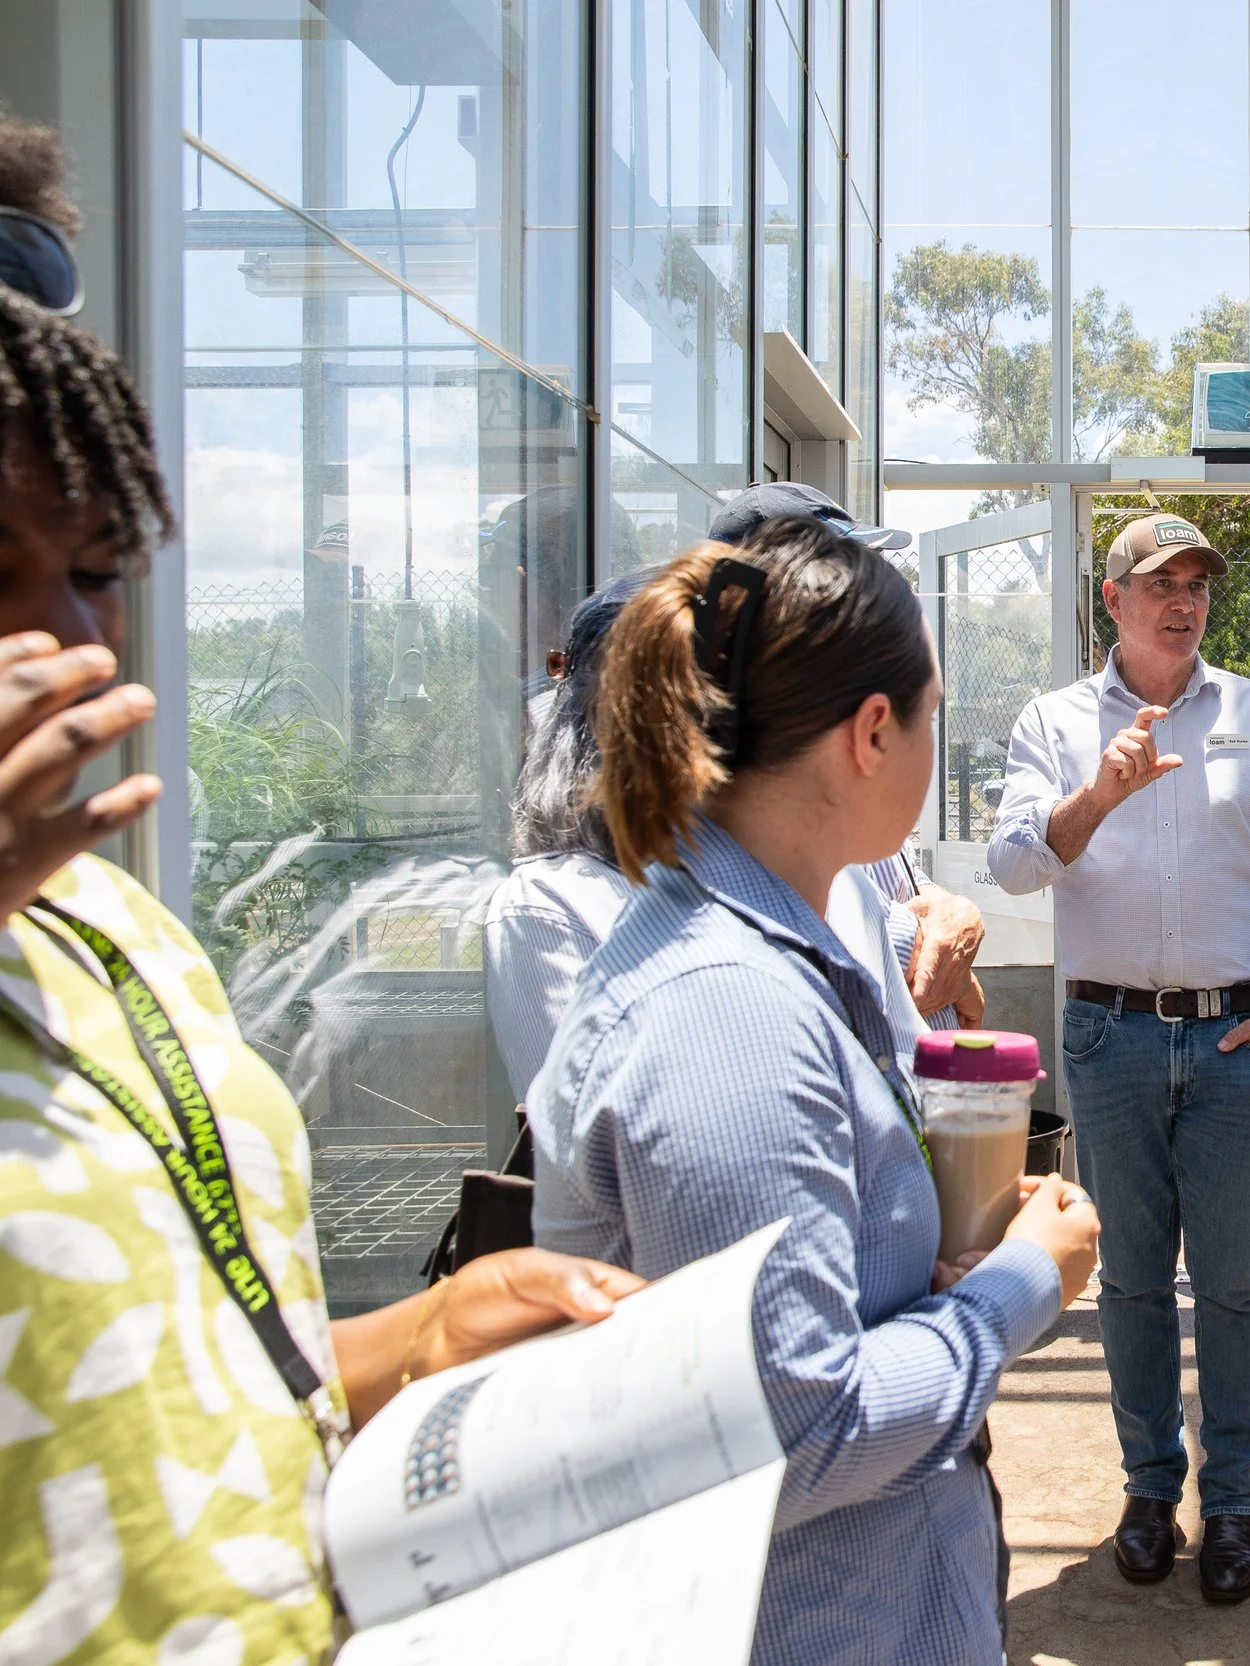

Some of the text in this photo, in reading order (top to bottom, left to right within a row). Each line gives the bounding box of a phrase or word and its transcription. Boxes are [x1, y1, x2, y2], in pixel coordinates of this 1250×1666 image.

[1160, 528, 1197, 542] loam
[120, 975, 171, 1042] HOUR
[150, 1038, 226, 1178] ASSISTANCE
[69, 1049, 270, 1314] une 24 HOUR ASSISTA
